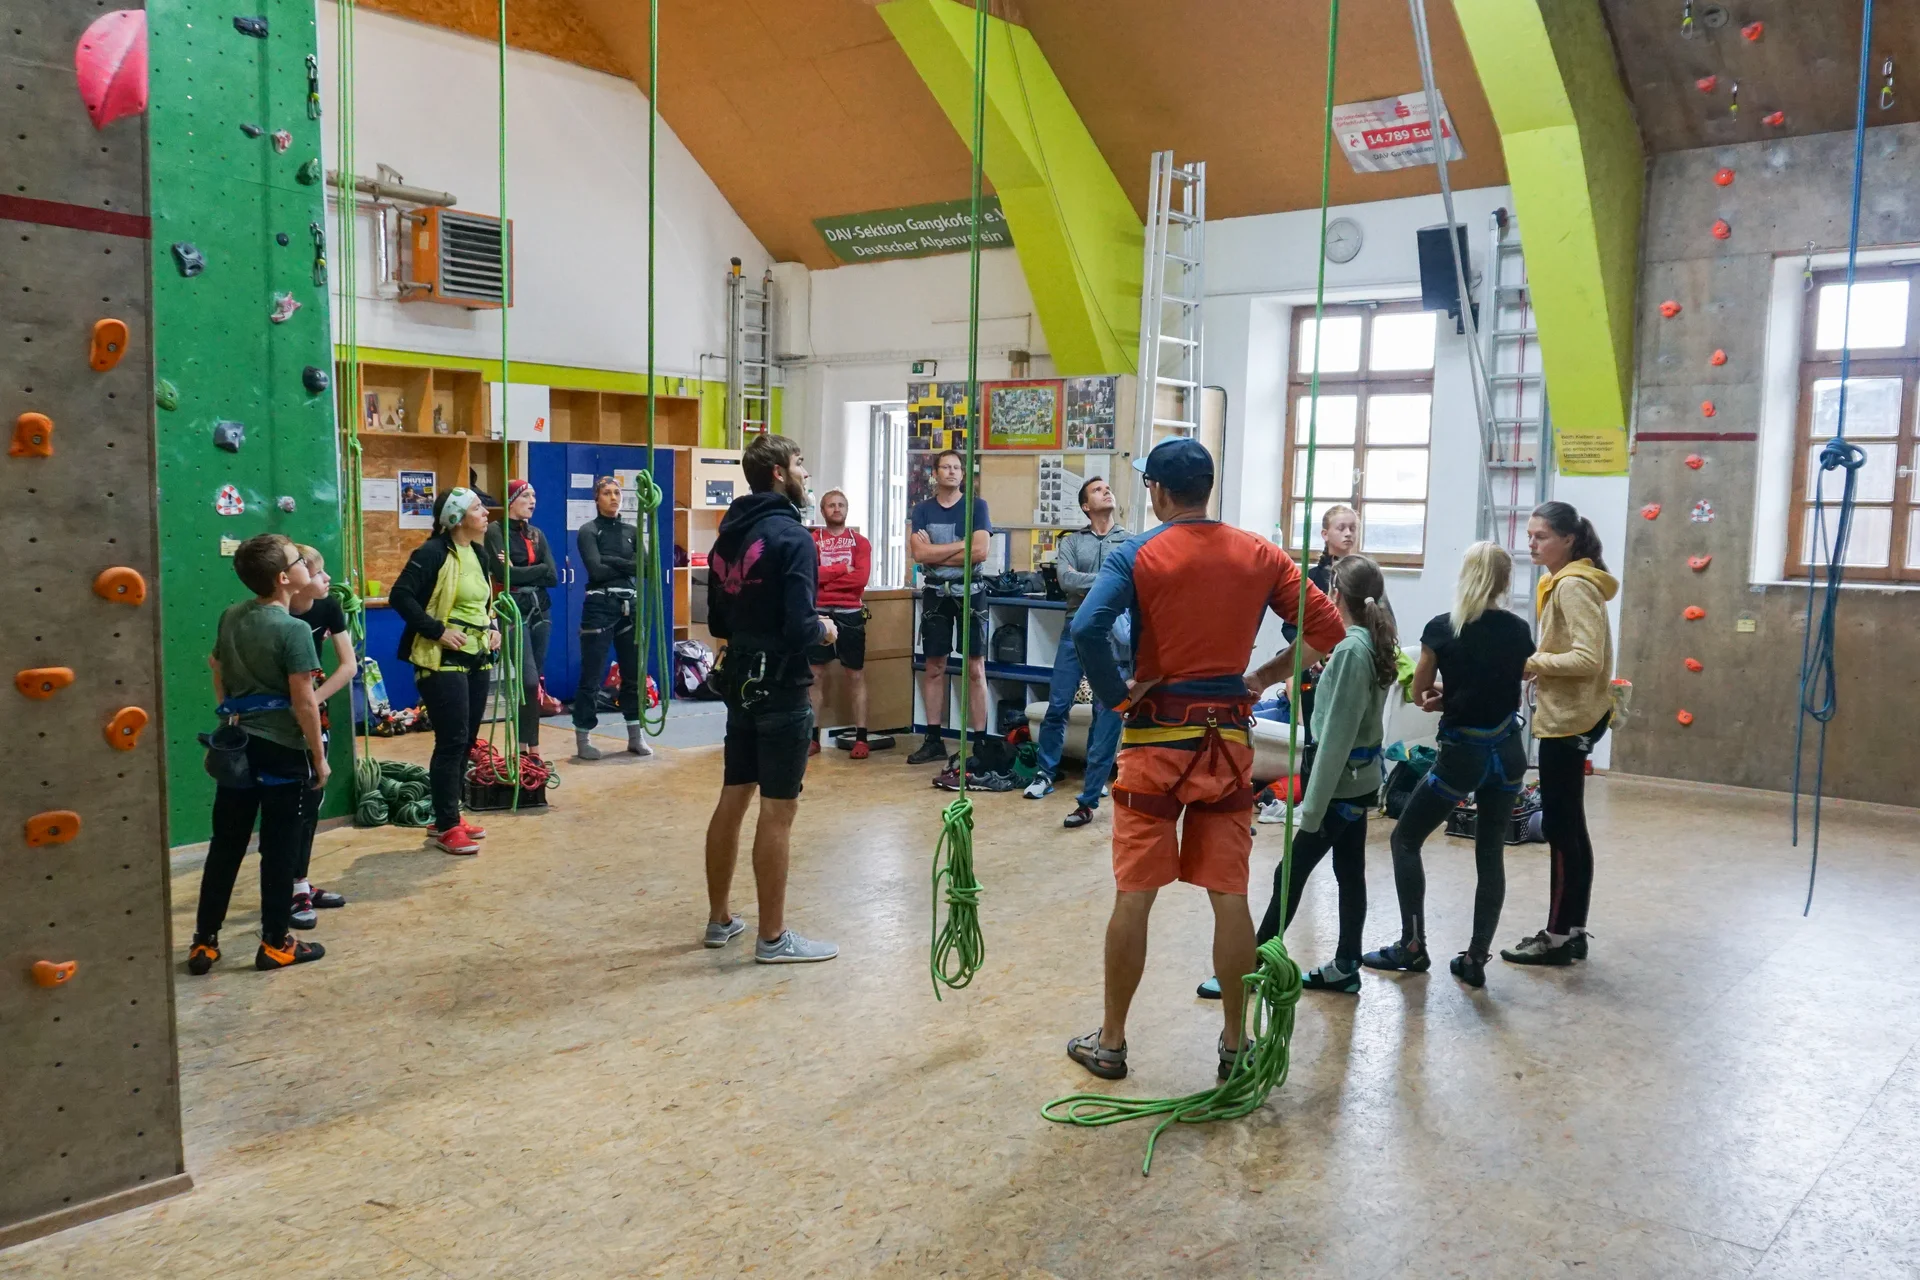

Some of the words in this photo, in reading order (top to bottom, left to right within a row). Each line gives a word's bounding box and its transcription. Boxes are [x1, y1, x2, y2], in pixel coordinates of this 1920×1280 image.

[1367, 129, 1410, 145] 14.789
[825, 223, 906, 242] DAV-Sektion
[852, 241, 918, 256] Deutscher
[920, 230, 1004, 249] Alpenveein
[402, 477, 432, 485] BHUTAN
